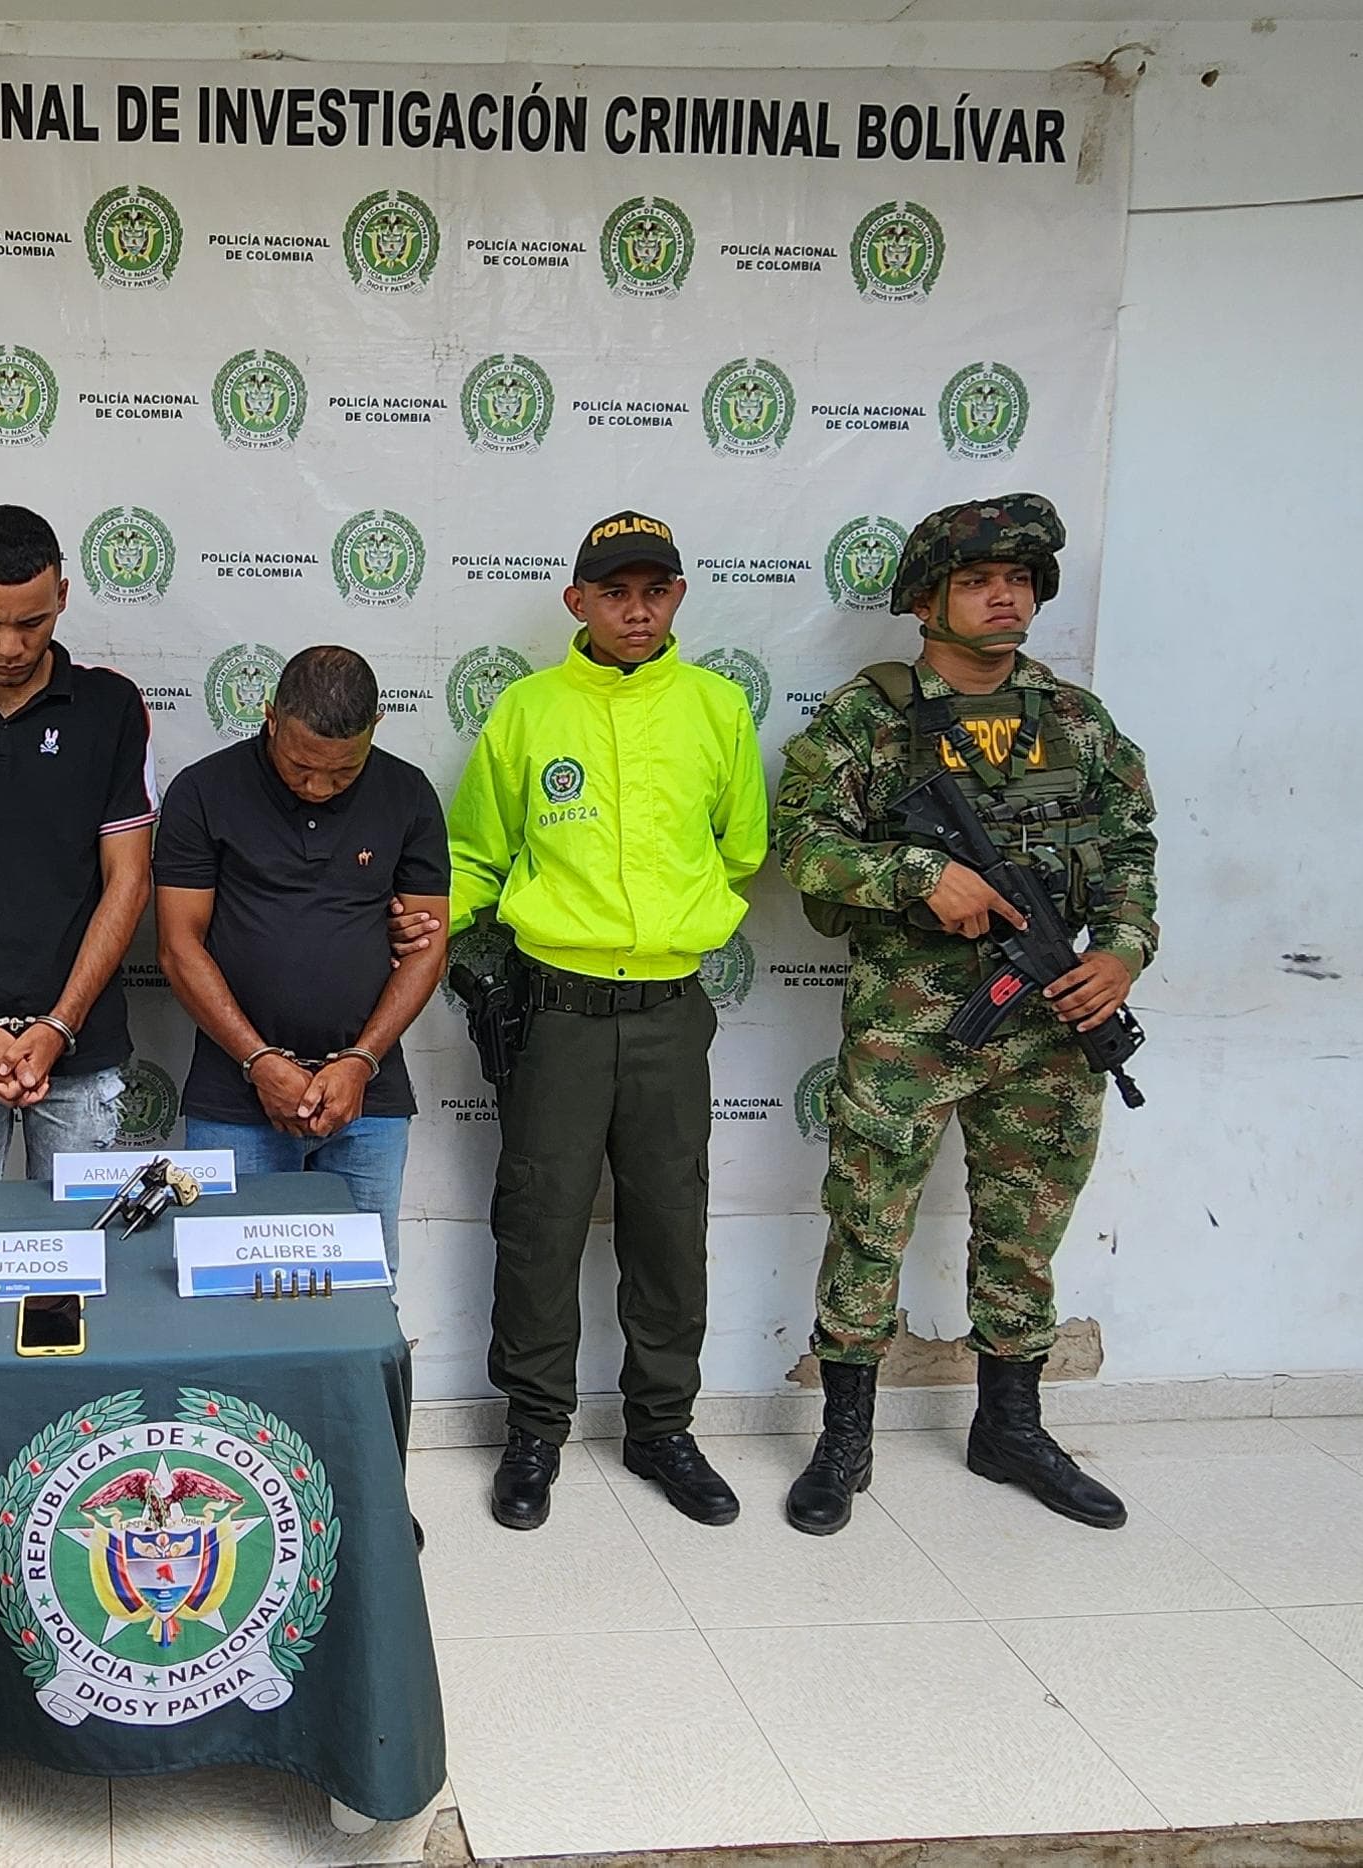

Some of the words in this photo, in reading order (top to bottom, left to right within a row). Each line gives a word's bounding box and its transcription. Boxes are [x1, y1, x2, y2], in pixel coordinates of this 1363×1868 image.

[118, 85, 179, 143] DE
[199, 82, 587, 153] INVESTIGACIÓN
[605, 95, 840, 158] CRIMINAL
[858, 92, 1067, 163] BOLÍVAR
[5, 231, 72, 243] NACIONAL
[209, 234, 261, 246] POLICÍA
[265, 236, 330, 247] NACIONAL
[467, 239, 518, 251] POLICÍA
[522, 242, 586, 252] NACIONAL
[721, 244, 770, 256] POLICÍA
[775, 247, 837, 257] NACIONAL
[226, 250, 242, 260] DE
[247, 251, 314, 262] COLOMBIA
[483, 255, 499, 265] DE
[504, 256, 569, 266] COLOMBIA
[737, 260, 753, 270] DE
[757, 261, 821, 271] COLOMBIA
[79, 392, 130, 404] POLICÍA
[134, 395, 199, 405] NACIONAL
[330, 396, 380, 408] POLICÍA
[384, 398, 447, 408] NACIONAL
[573, 400, 623, 411] POLICÍA
[627, 402, 689, 412] NACIONAL
[812, 404, 860, 415] POLICÍA
[864, 406, 926, 416] NACIONAL
[95, 409, 111, 418] DE
[115, 409, 183, 419] COLOMBIA
[345, 412, 361, 421] DE
[366, 412, 431, 422] COLOMBIA
[588, 416, 604, 425] DE
[609, 416, 673, 426] COLOMBIA
[826, 419, 841, 429] DE
[846, 420, 909, 430] COLOMBIA
[202, 552, 249, 564] POLICÍA
[254, 554, 318, 564] NACIONAL
[452, 554, 500, 566] POLICÍA
[505, 557, 567, 566] NACIONAL
[697, 557, 745, 568] POLICÍA
[750, 559, 812, 569] NACIONAL
[218, 568, 233, 577] DE
[238, 568, 303, 577] COLOMBIA
[468, 571, 483, 580] DE
[488, 571, 551, 580] COLOMBIA
[712, 573, 727, 582] DE
[732, 573, 795, 583] COLOMBIA
[139, 688, 192, 697] ACIONAL
[379, 689, 434, 699] ACIONAL
[147, 701, 176, 710] MBIA
[378, 703, 418, 712] OMBIA
[770, 963, 816, 974] POLICÍA
[784, 978, 799, 986] DE
[441, 1097, 488, 1109] POLICÍA
[724, 1098, 783, 1108] NACIONAL
[456, 1112, 471, 1121] DE
[84, 1168, 130, 1180] ARMA
[243, 1223, 334, 1239] MUNICION
[236, 1245, 317, 1260] CALIBRE
[323, 1244, 342, 1257] 38
[147, 1428, 184, 1446] DE
[215, 1439, 298, 1565] COLOMBIA
[168, 1593, 286, 1686] NACIONAL
[76, 1682, 138, 1716] DIOS
[143, 1700, 159, 1717] Y
[168, 1667, 256, 1718] PATRIA
